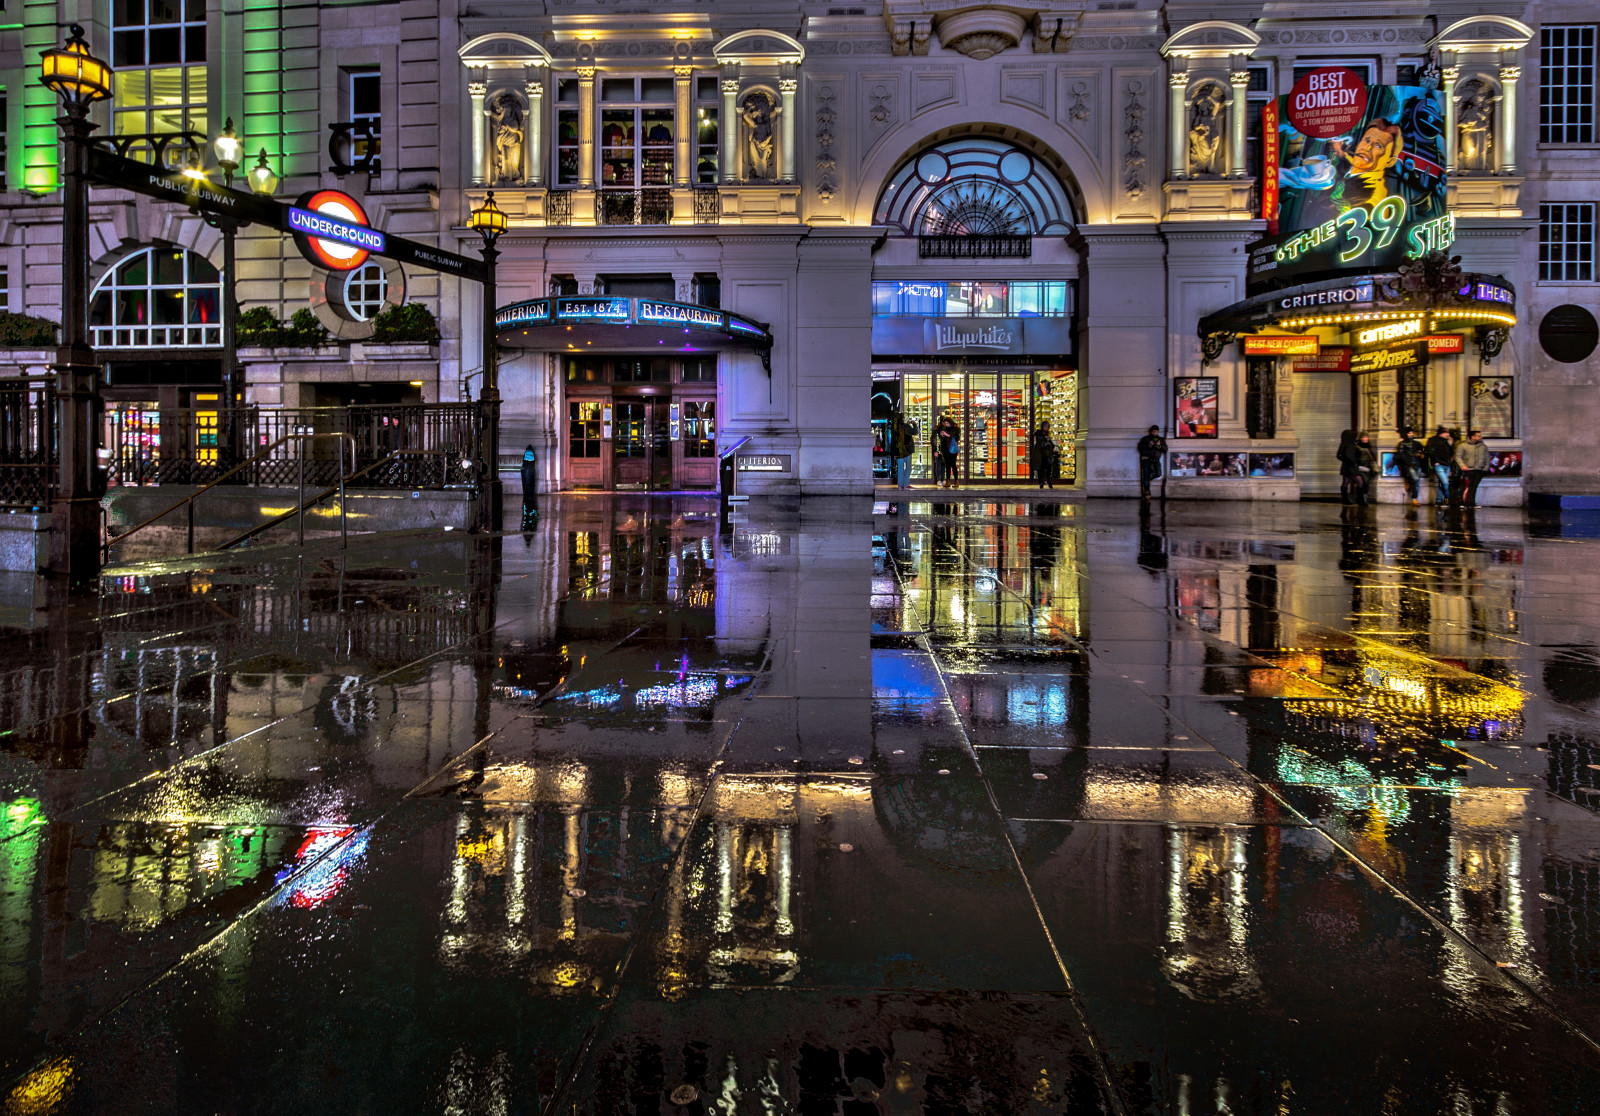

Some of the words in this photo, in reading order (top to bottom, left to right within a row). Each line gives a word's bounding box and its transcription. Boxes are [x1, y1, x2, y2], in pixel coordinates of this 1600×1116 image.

[1309, 71, 1346, 91] BEST
[1295, 87, 1359, 110] COMEDY
[1295, 109, 1320, 120] OLIVIER
[1321, 107, 1343, 117] AWARD
[1344, 106, 1359, 115] 2007
[1303, 119, 1308, 127] 2
[1309, 117, 1324, 126] TONY
[1325, 115, 1351, 124] AWARDS
[1320, 124, 1335, 133] 2008
[1266, 165, 1276, 190] 39
[149, 175, 188, 194] PUBLIC
[191, 188, 236, 206] SUBWAY
[291, 211, 382, 248] UNDERGROUND
[1336, 195, 1407, 263] 39
[414, 249, 437, 262] PUBLIC
[437, 256, 463, 269] SUBWAY
[1281, 286, 1368, 308] CRITERION
[496, 303, 545, 323] CRITERION
[593, 302, 621, 314] 1874
[642, 303, 721, 324] RESTAURANT
[935, 323, 1012, 350] Lillywhites
[1359, 319, 1421, 344] CRITERION
[1248, 339, 1265, 349] BEST
[1268, 339, 1282, 349] NEW
[1428, 338, 1460, 348] COMEDY
[1370, 349, 1388, 370] 39
